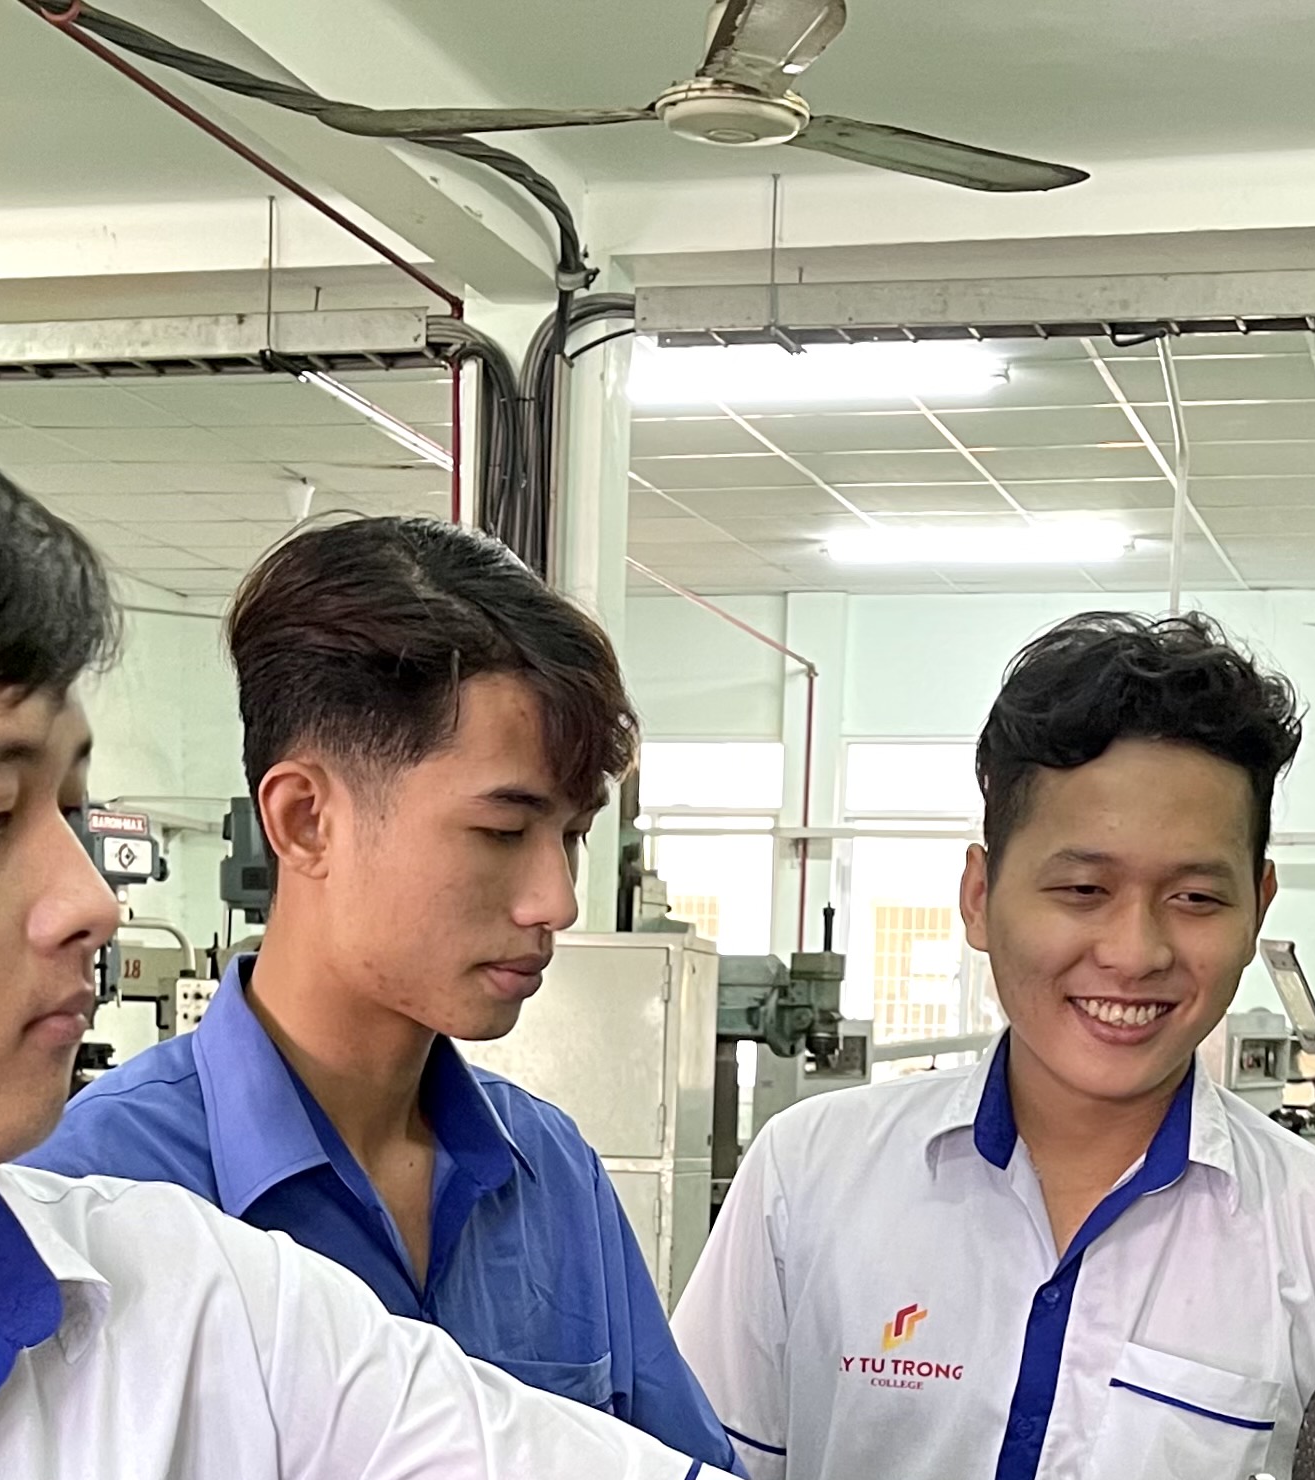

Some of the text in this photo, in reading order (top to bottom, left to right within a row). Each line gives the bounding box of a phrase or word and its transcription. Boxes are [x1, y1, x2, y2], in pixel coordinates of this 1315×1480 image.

[124, 959, 141, 979] 18
[859, 1357, 886, 1374] TU
[891, 1359, 964, 1381] TRONG
[871, 1377, 925, 1391] COLLEGE
